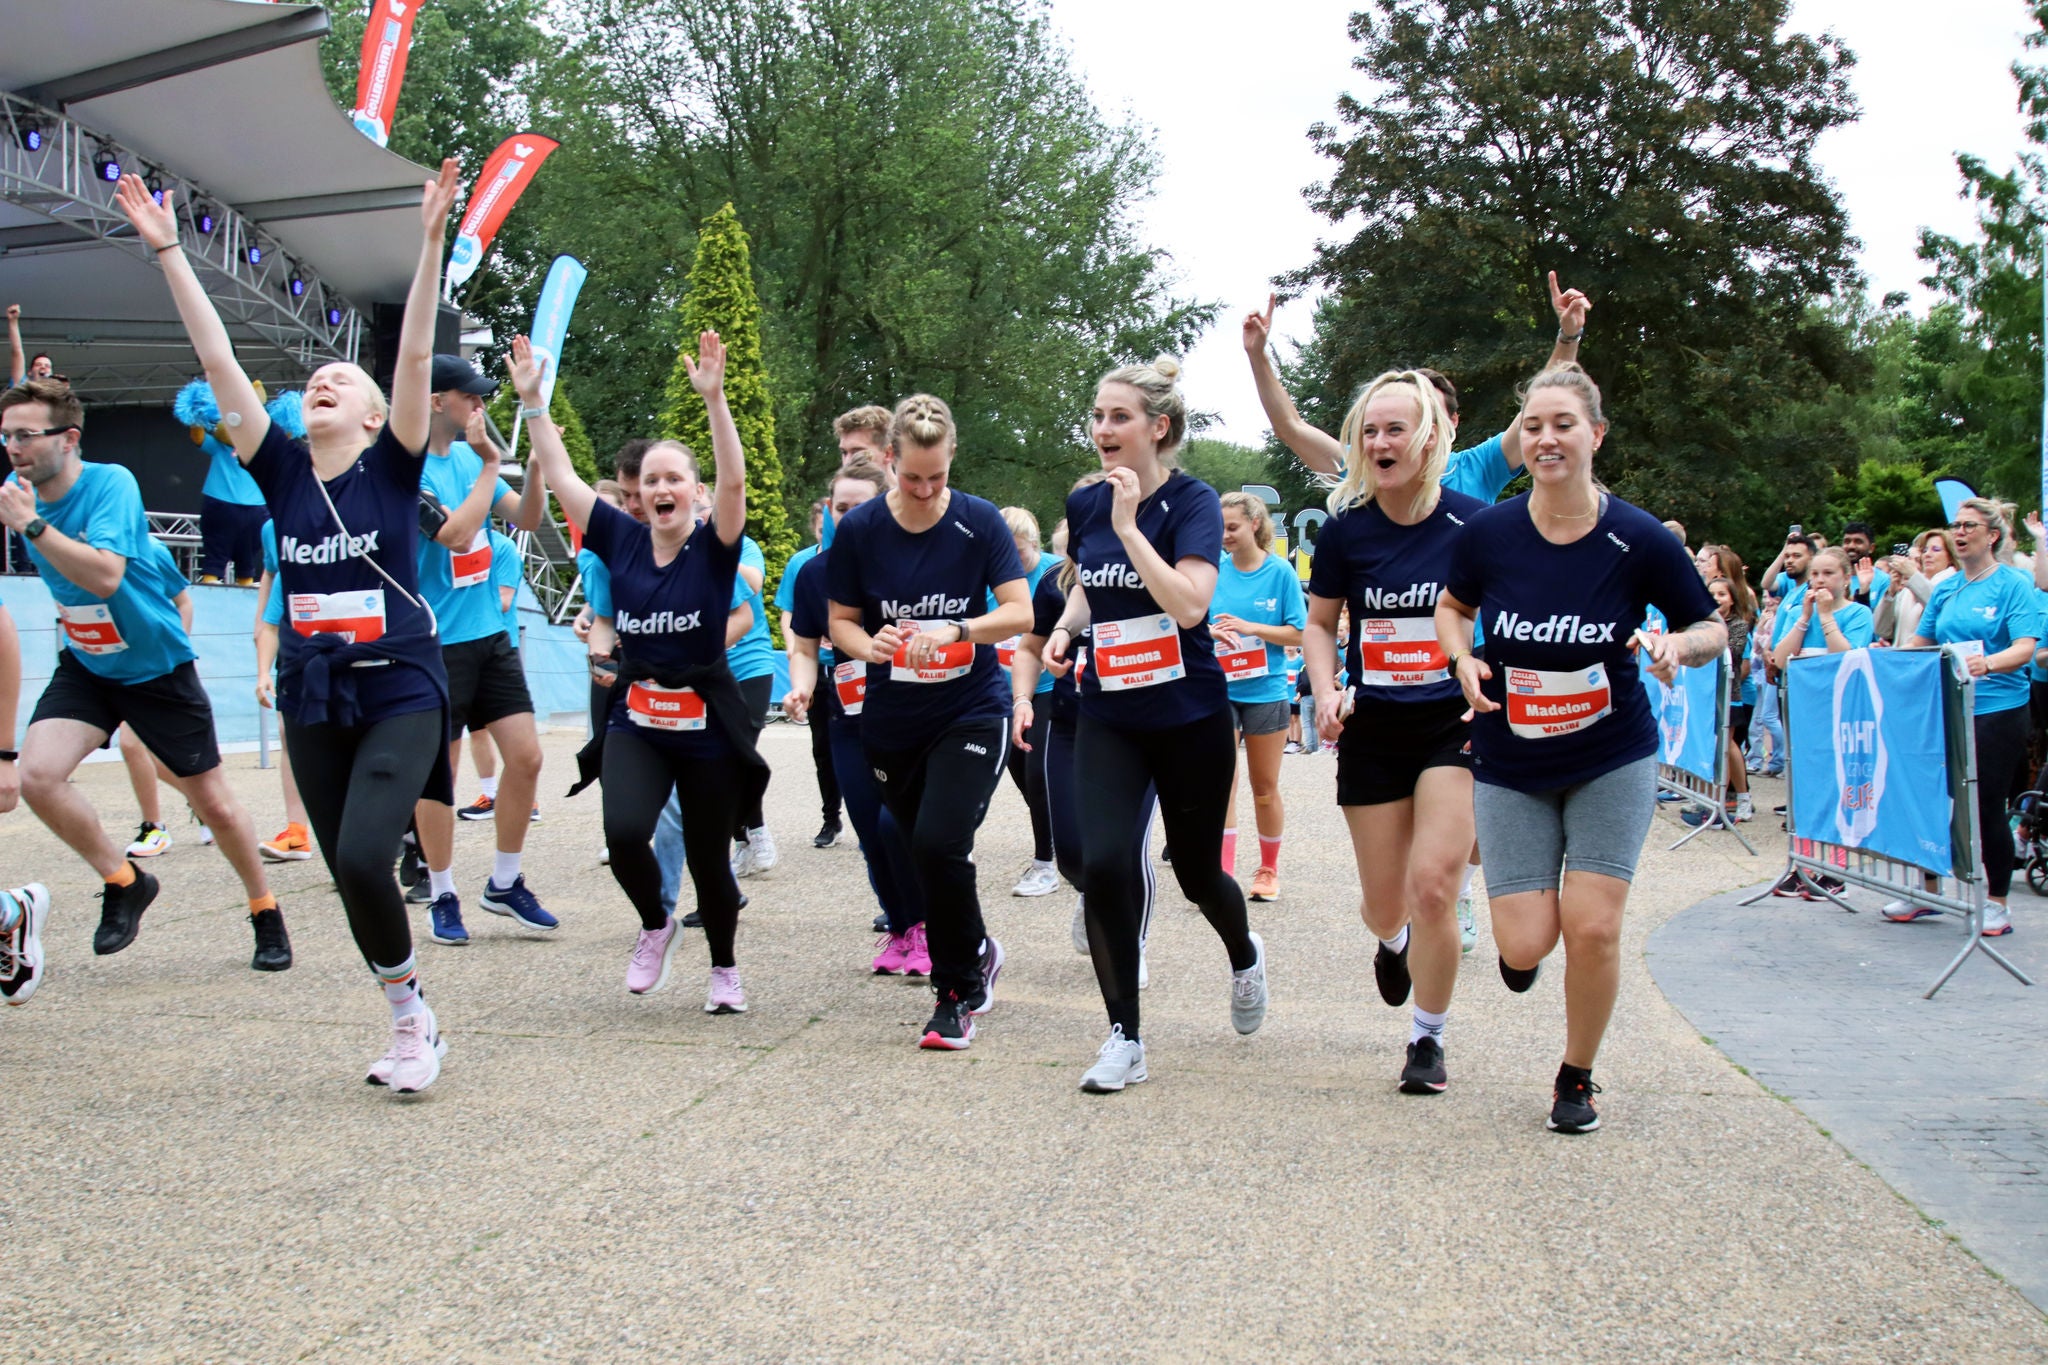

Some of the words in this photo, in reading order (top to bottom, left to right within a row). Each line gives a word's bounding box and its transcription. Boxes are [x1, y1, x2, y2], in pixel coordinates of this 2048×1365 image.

[366, 44, 393, 118] ROLLERCOASTER
[464, 178, 507, 236] ROLLERCOASTER
[281, 530, 380, 564] Nedflex
[881, 593, 971, 619] Nedflex
[1365, 582, 1445, 610] Nedfl
[616, 610, 701, 634] Nedflex
[1493, 610, 1616, 644] Nedflex
[1109, 650, 1162, 668] Ramona
[1383, 649, 1431, 664] Bonnie
[648, 697, 681, 711] Tessa
[1525, 701, 1592, 717] Madelon
[964, 743, 987, 755] JAKO
